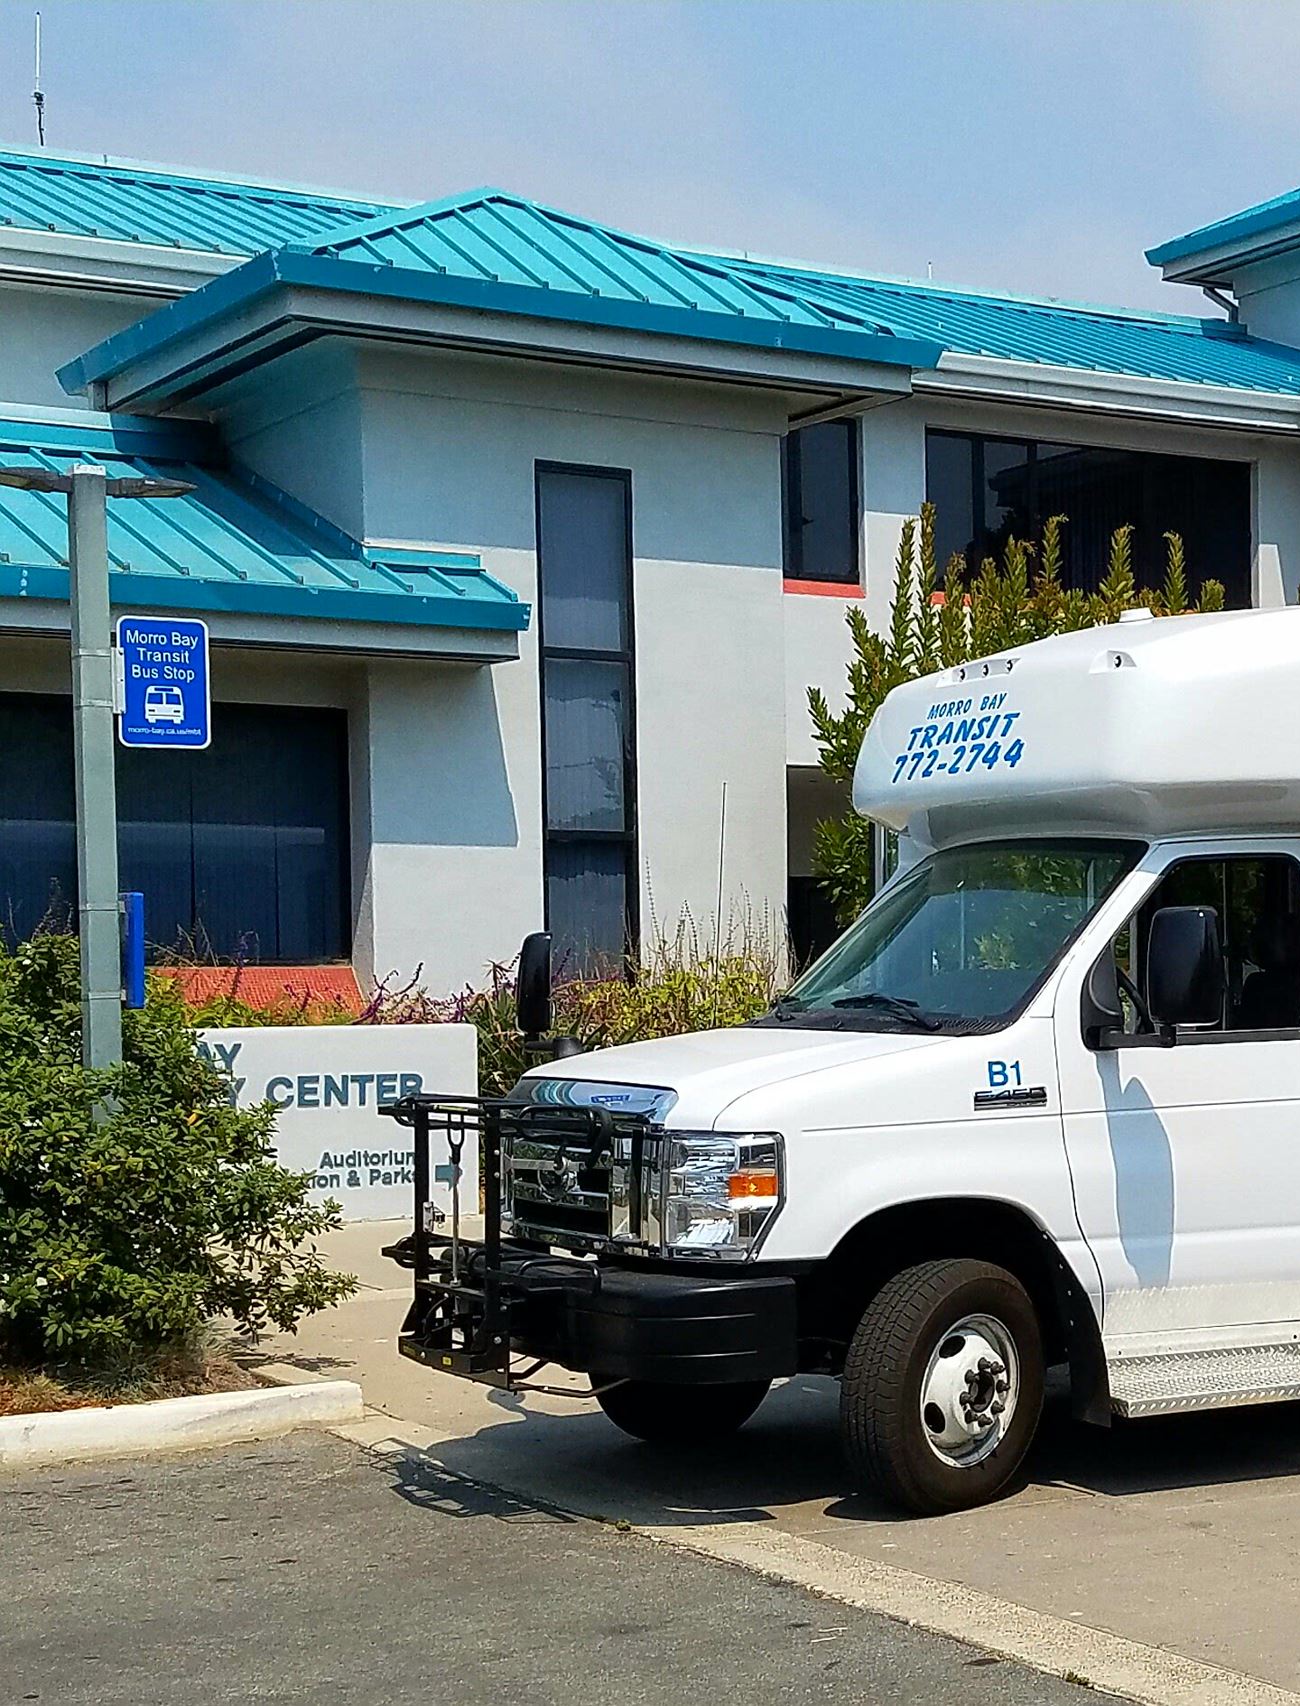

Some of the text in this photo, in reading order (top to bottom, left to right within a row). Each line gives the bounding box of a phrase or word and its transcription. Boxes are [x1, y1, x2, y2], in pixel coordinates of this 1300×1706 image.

[126, 629, 199, 650] Morro Bay
[136, 648, 190, 664] Transit
[131, 665, 195, 683] Bus Stop
[927, 692, 1008, 720] MORRO BAY
[907, 712, 1021, 751] TRANSIT
[892, 738, 1025, 784] 772-2744
[196, 1041, 243, 1073] AY
[988, 1060, 1021, 1087] B1
[265, 1073, 424, 1108] CENTER
[346, 1169, 361, 1187] &
[369, 1166, 416, 1186] Park
